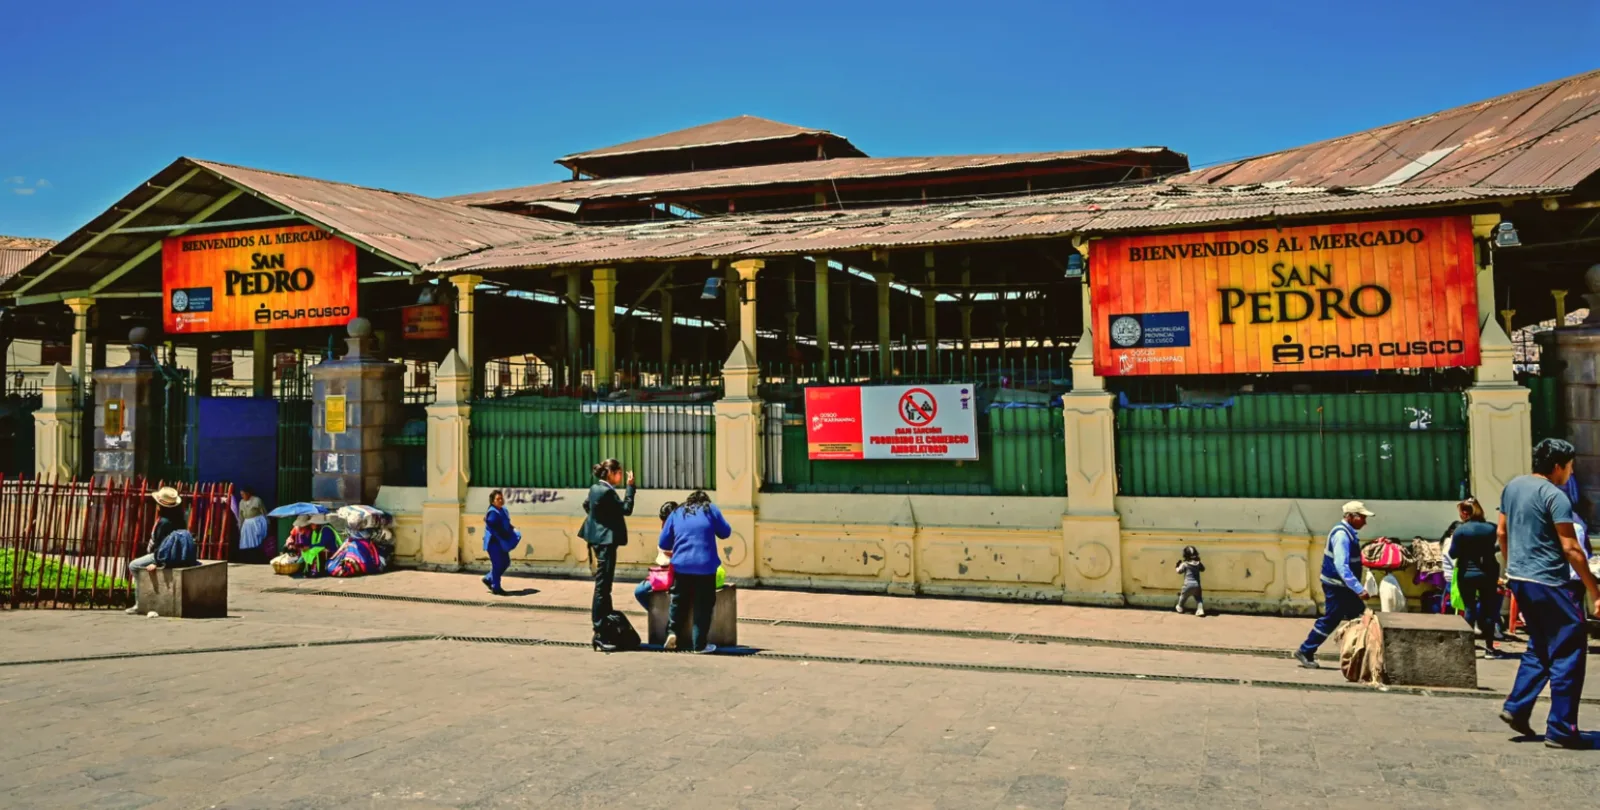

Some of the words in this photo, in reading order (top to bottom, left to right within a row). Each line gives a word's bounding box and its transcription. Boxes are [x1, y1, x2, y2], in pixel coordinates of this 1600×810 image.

[182, 235, 255, 252] BIENVENIDOS
[258, 233, 272, 246] AL
[275, 230, 333, 244] MERCADO
[1129, 239, 1269, 262] BIENVENIDOS
[1276, 238, 1303, 253] AL
[1309, 228, 1424, 251] MERCADO
[251, 252, 285, 270] SAN
[225, 267, 315, 296] PEDRO
[1271, 263, 1333, 288] SAN
[273, 308, 306, 320] CAJA
[308, 306, 351, 318] CUSCO
[1217, 284, 1392, 326] PEDRO
[1308, 343, 1377, 360] CAJA
[1379, 340, 1464, 357] CUSCO
[869, 435, 914, 444] PROHIBIDO
[915, 435, 924, 444] EL
[925, 434, 969, 444] COMERCIO
